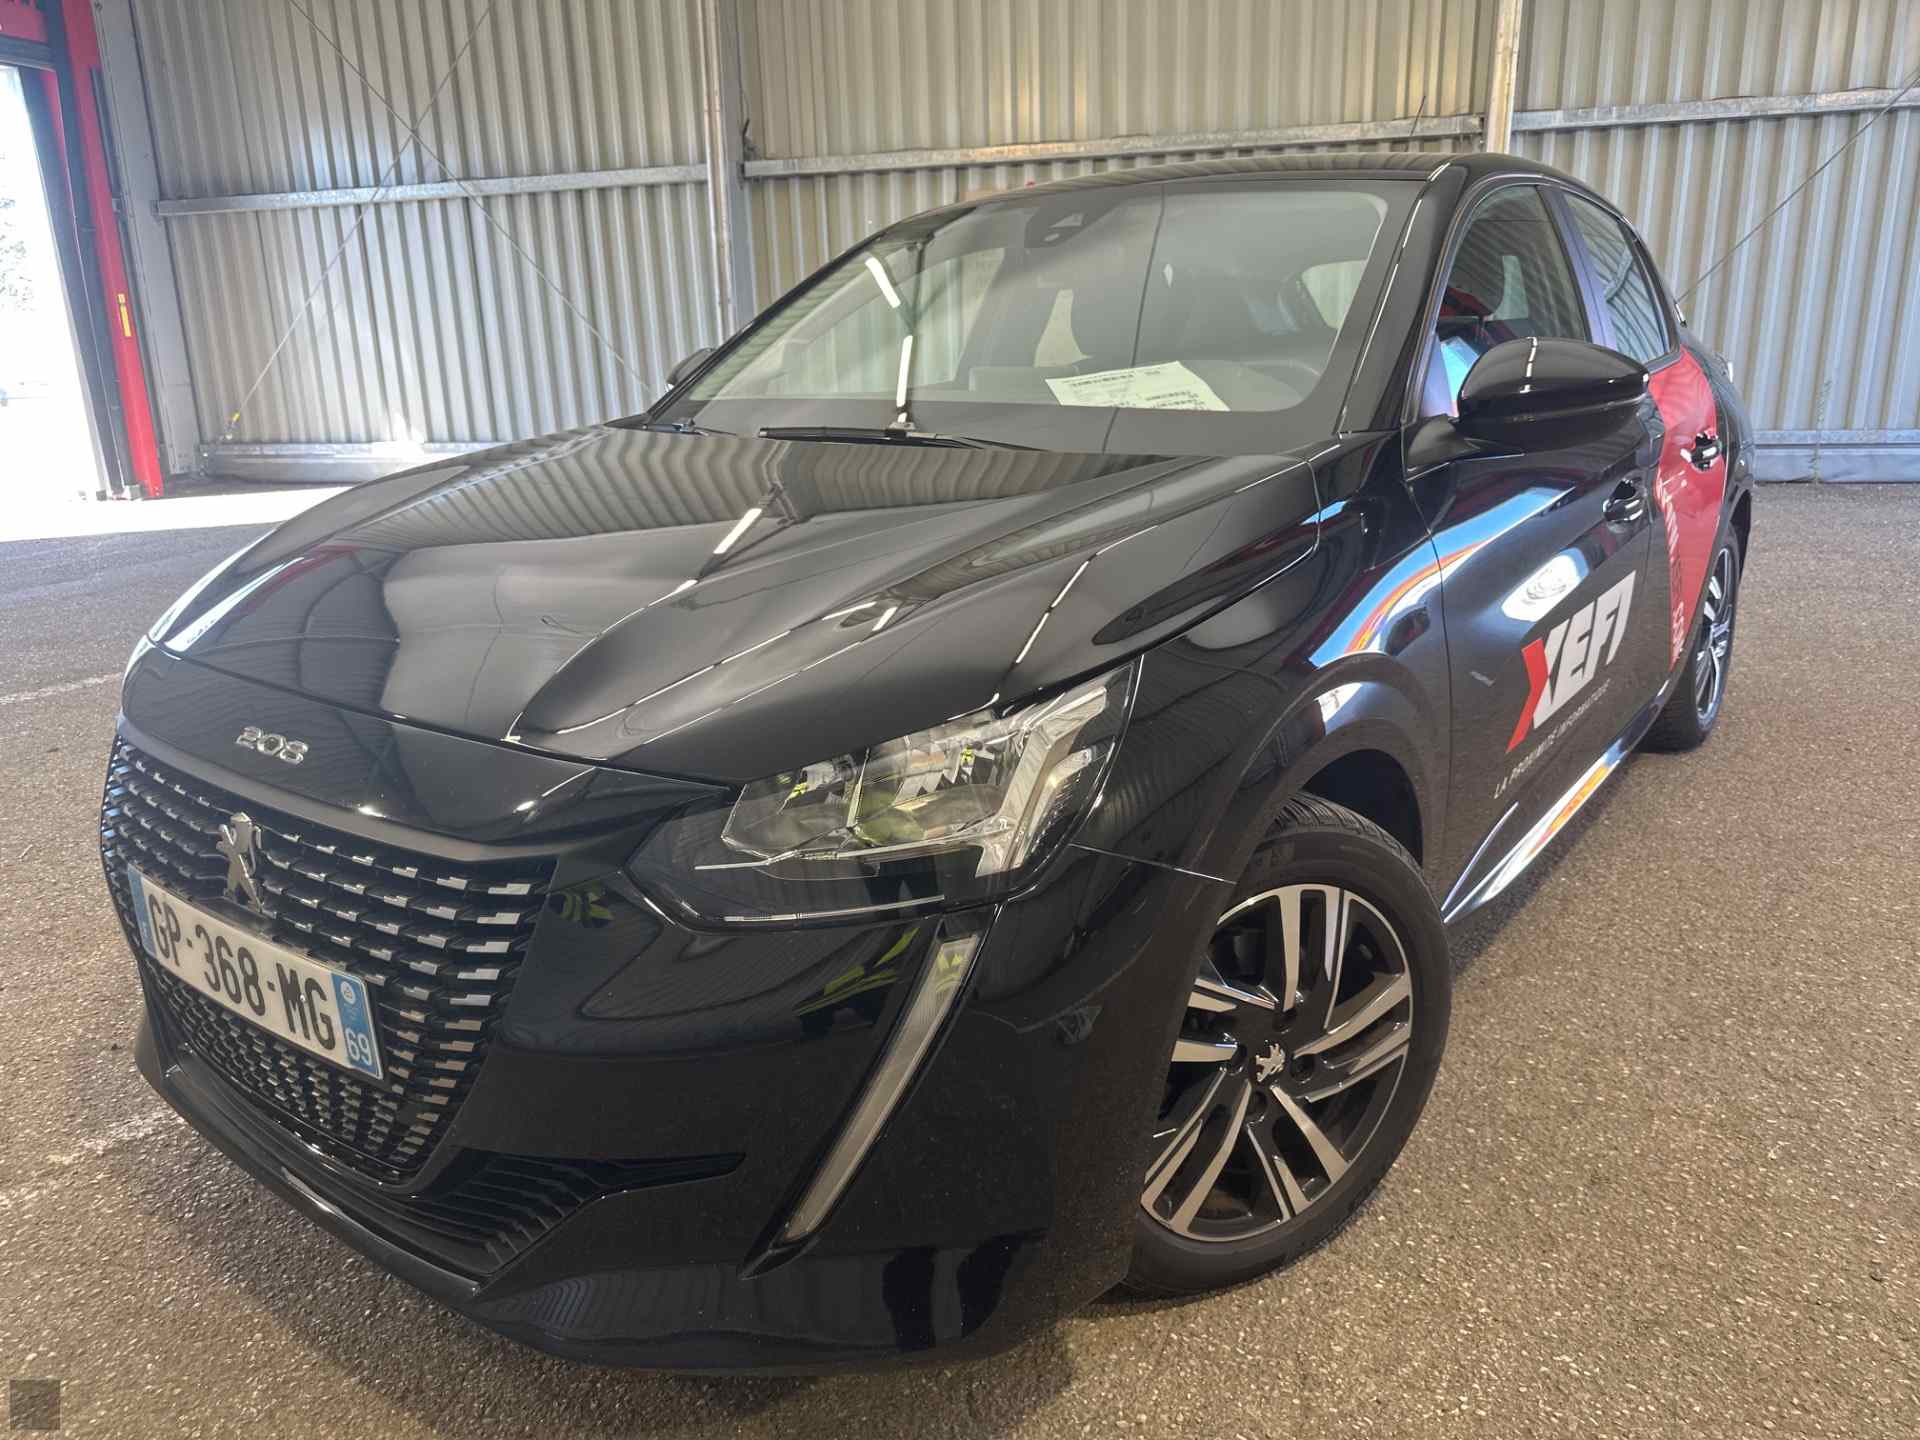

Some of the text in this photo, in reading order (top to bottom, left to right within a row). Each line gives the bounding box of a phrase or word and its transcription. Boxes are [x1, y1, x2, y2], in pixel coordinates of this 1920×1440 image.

[236, 726, 309, 765] 208
[149, 894, 336, 1051] GP-368-MG
[344, 1027, 373, 1066] 69
